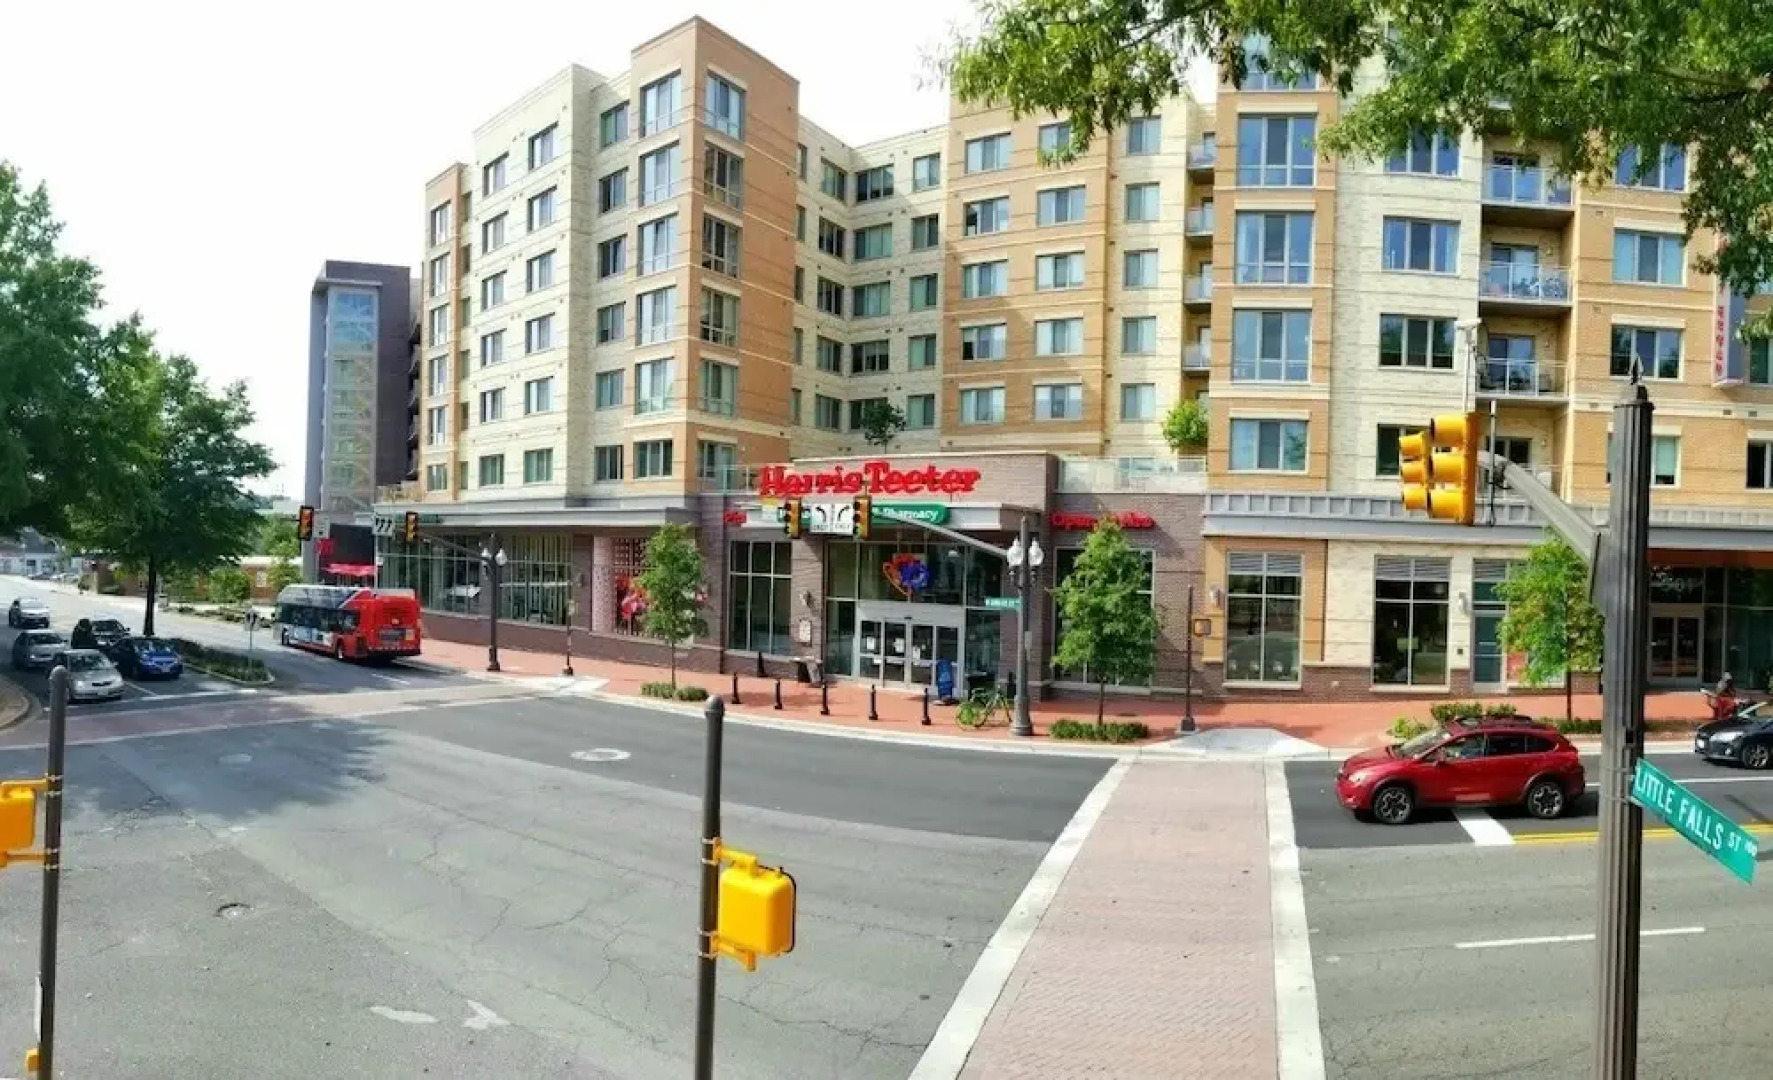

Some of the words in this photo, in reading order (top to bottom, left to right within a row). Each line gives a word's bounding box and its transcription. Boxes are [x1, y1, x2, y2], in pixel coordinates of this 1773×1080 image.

[759, 465, 863, 496] Harris
[864, 461, 981, 494] Teeter
[1634, 765, 1676, 814] LITTLE
[1678, 797, 1724, 850] FALLS
[1727, 830, 1742, 852] ST
